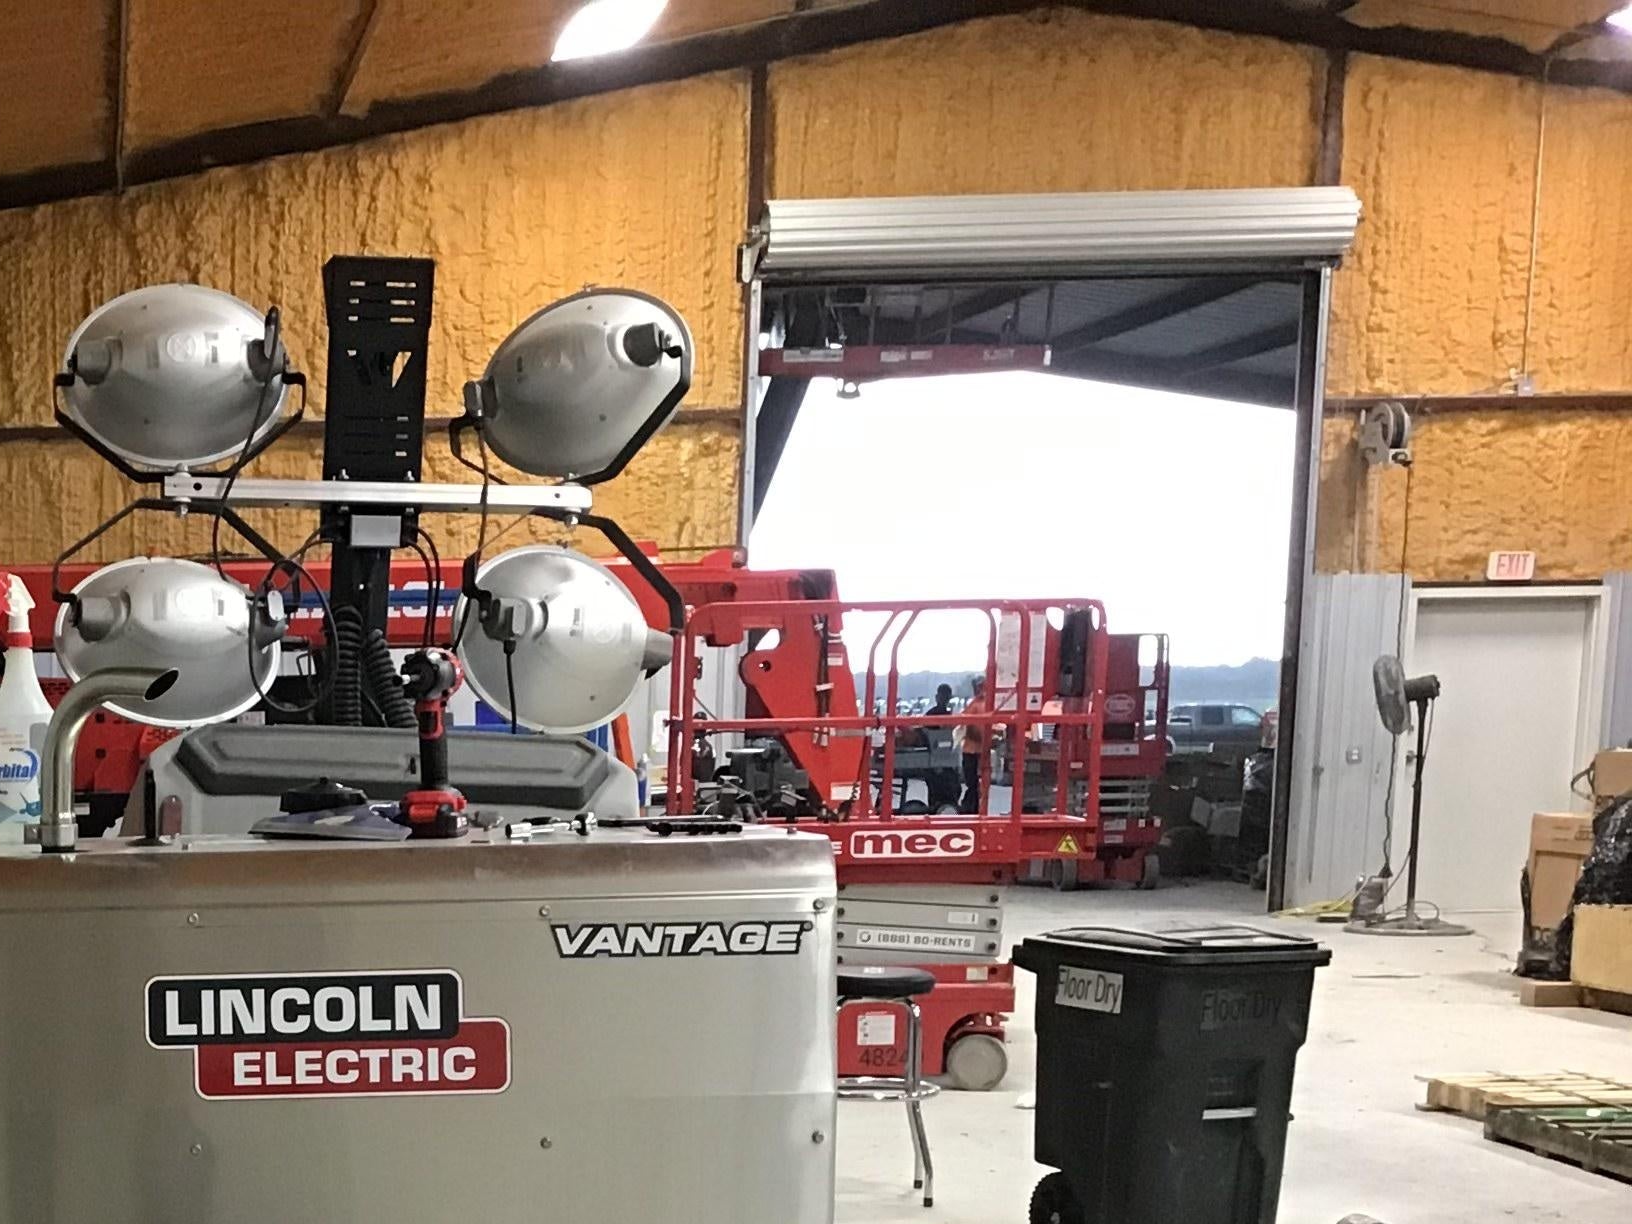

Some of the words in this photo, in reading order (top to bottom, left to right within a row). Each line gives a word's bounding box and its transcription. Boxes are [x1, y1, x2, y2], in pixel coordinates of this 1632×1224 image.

[1496, 553, 1530, 577] EXIT
[853, 833, 972, 855] mec
[552, 921, 804, 958] VANTAGE
[877, 933, 910, 945] (888)
[913, 935, 972, 948] 80-RENTS
[1057, 967, 1092, 1001] Floor
[1094, 974, 1121, 1014] Dry
[165, 984, 441, 1036] LINCOLN
[233, 1046, 476, 1087] ELECTRIC
